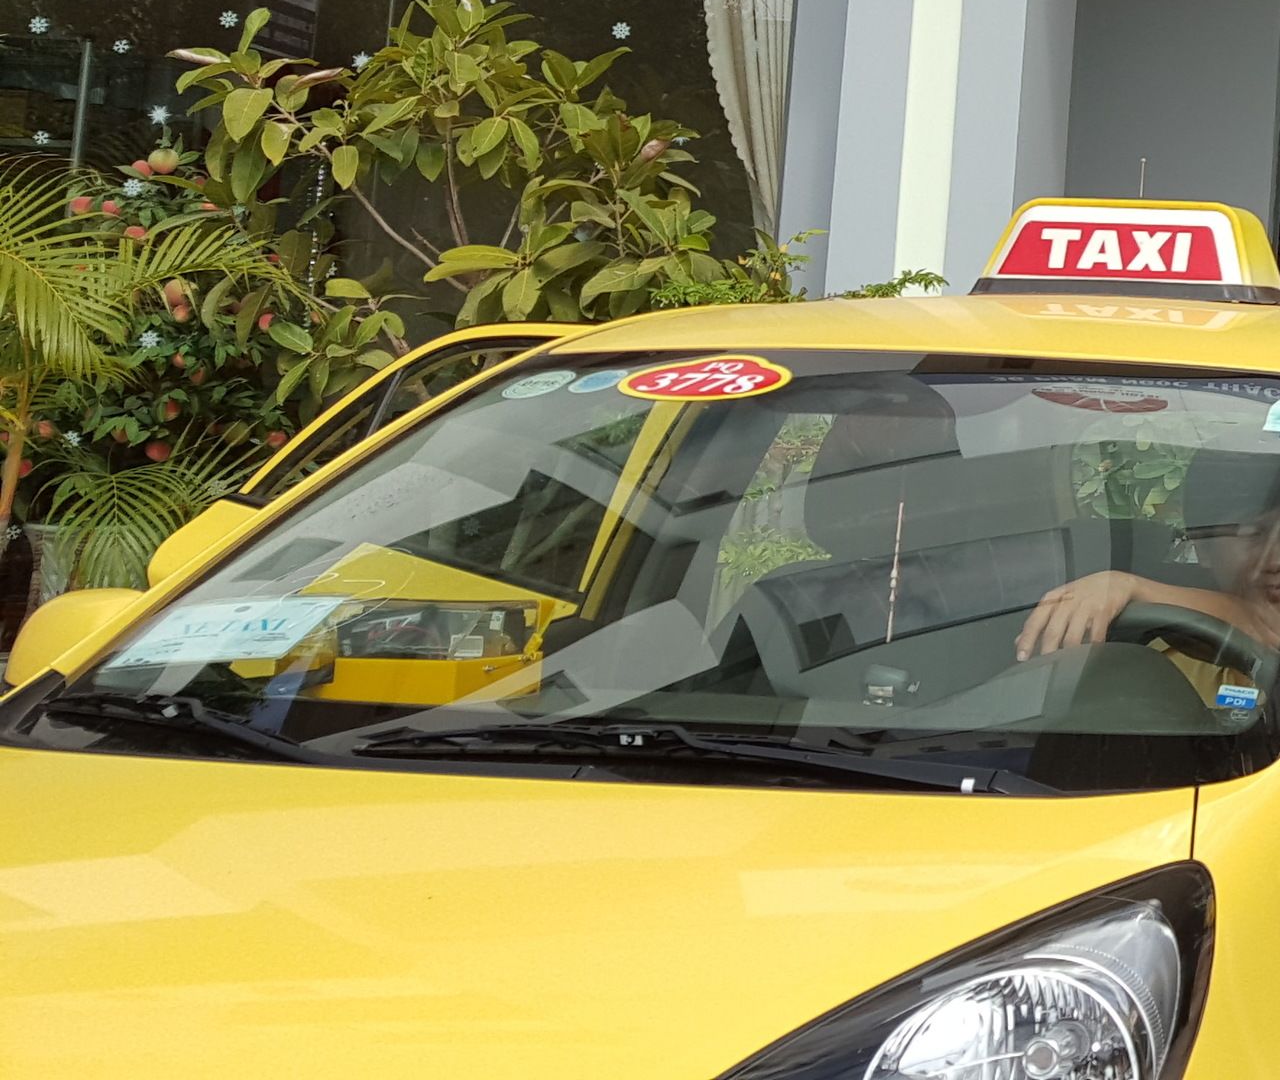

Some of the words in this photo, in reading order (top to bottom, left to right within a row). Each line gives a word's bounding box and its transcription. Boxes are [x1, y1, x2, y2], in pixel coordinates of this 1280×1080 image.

[1040, 227, 1193, 273] TAXI
[637, 372, 765, 394] 3778
[1224, 697, 1247, 706] PDI
